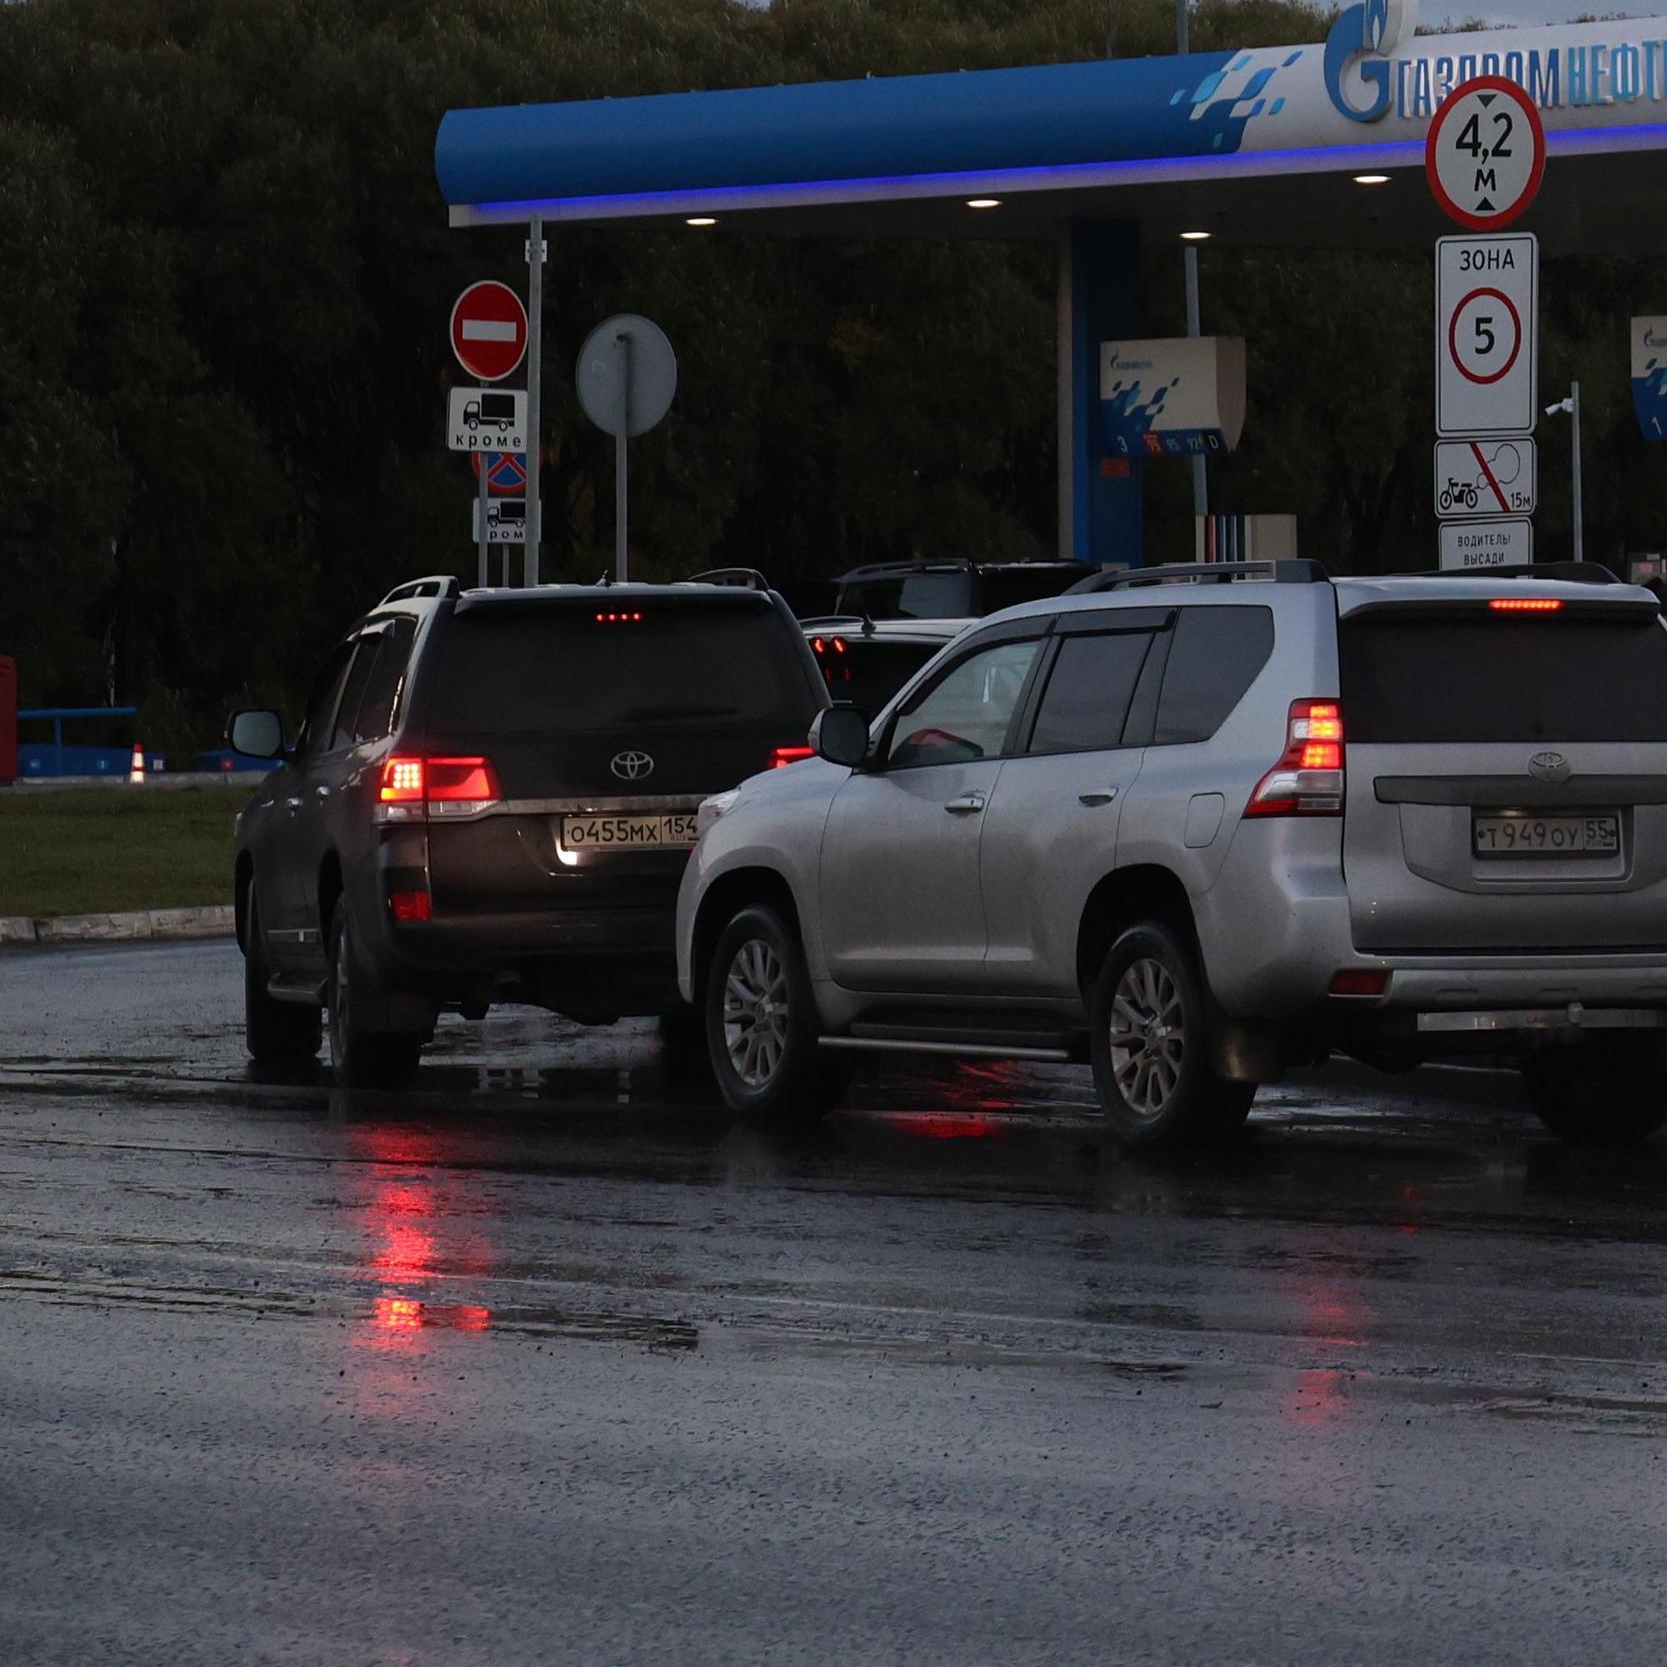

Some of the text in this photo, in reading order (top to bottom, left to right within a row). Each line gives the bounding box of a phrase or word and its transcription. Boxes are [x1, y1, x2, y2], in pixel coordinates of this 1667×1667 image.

[1455, 112, 1513, 165] 4,2
[1460, 248, 1515, 271] ЗОНА
[1475, 316, 1495, 354] 5
[456, 435, 521, 448] кроме
[1117, 435, 1128, 453] 3
[1464, 552, 1504, 565] ВЫСАДИ
[664, 817, 698, 834] 154
[1586, 820, 1609, 839] 55
